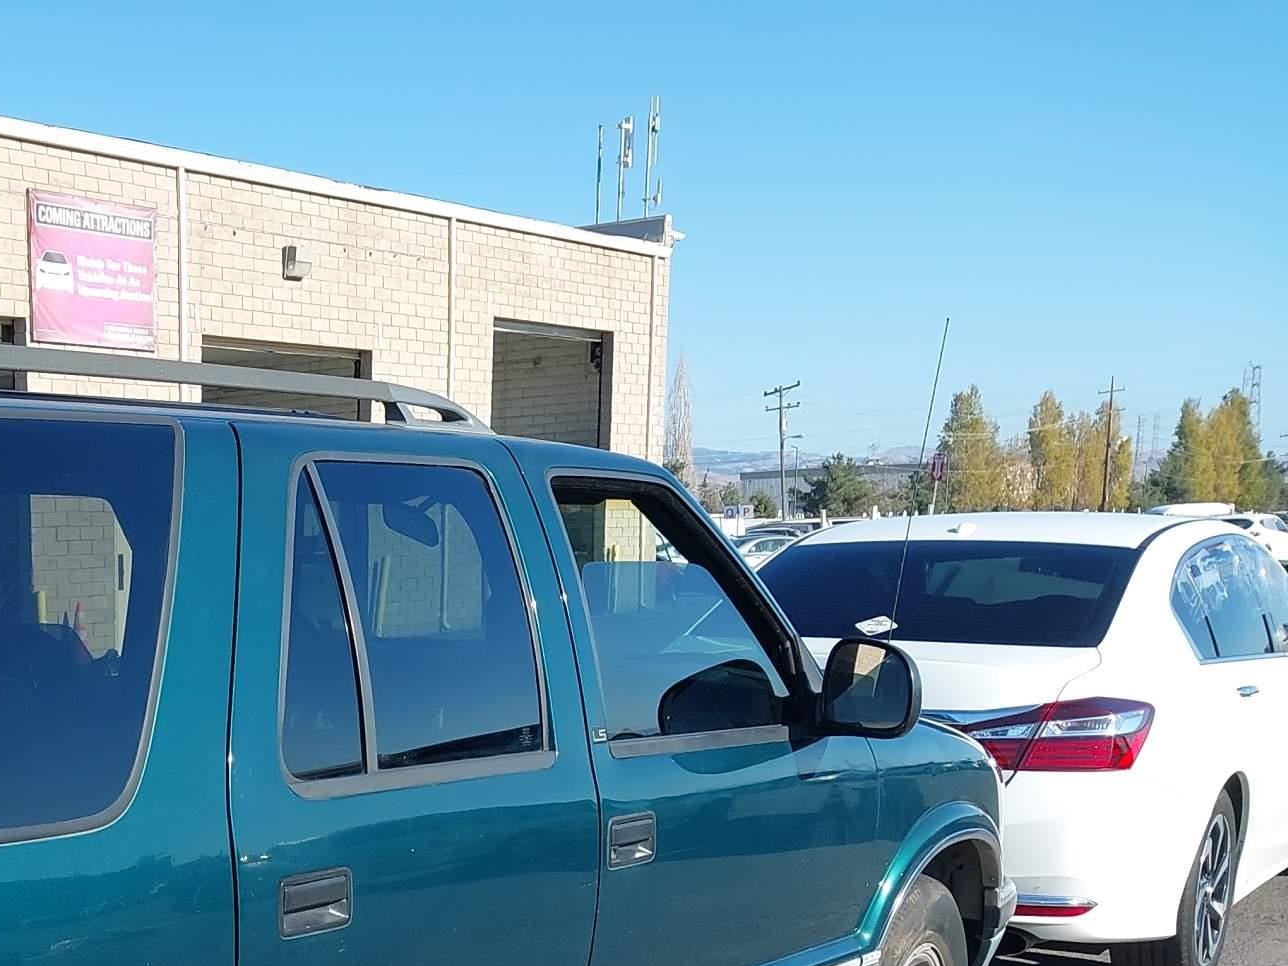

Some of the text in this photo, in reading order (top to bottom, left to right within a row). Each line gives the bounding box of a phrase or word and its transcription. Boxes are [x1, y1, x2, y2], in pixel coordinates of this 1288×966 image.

[38, 205, 151, 238] COMING ATTRACTIONS
[743, 507, 751, 517] P
[592, 728, 607, 741] LS
